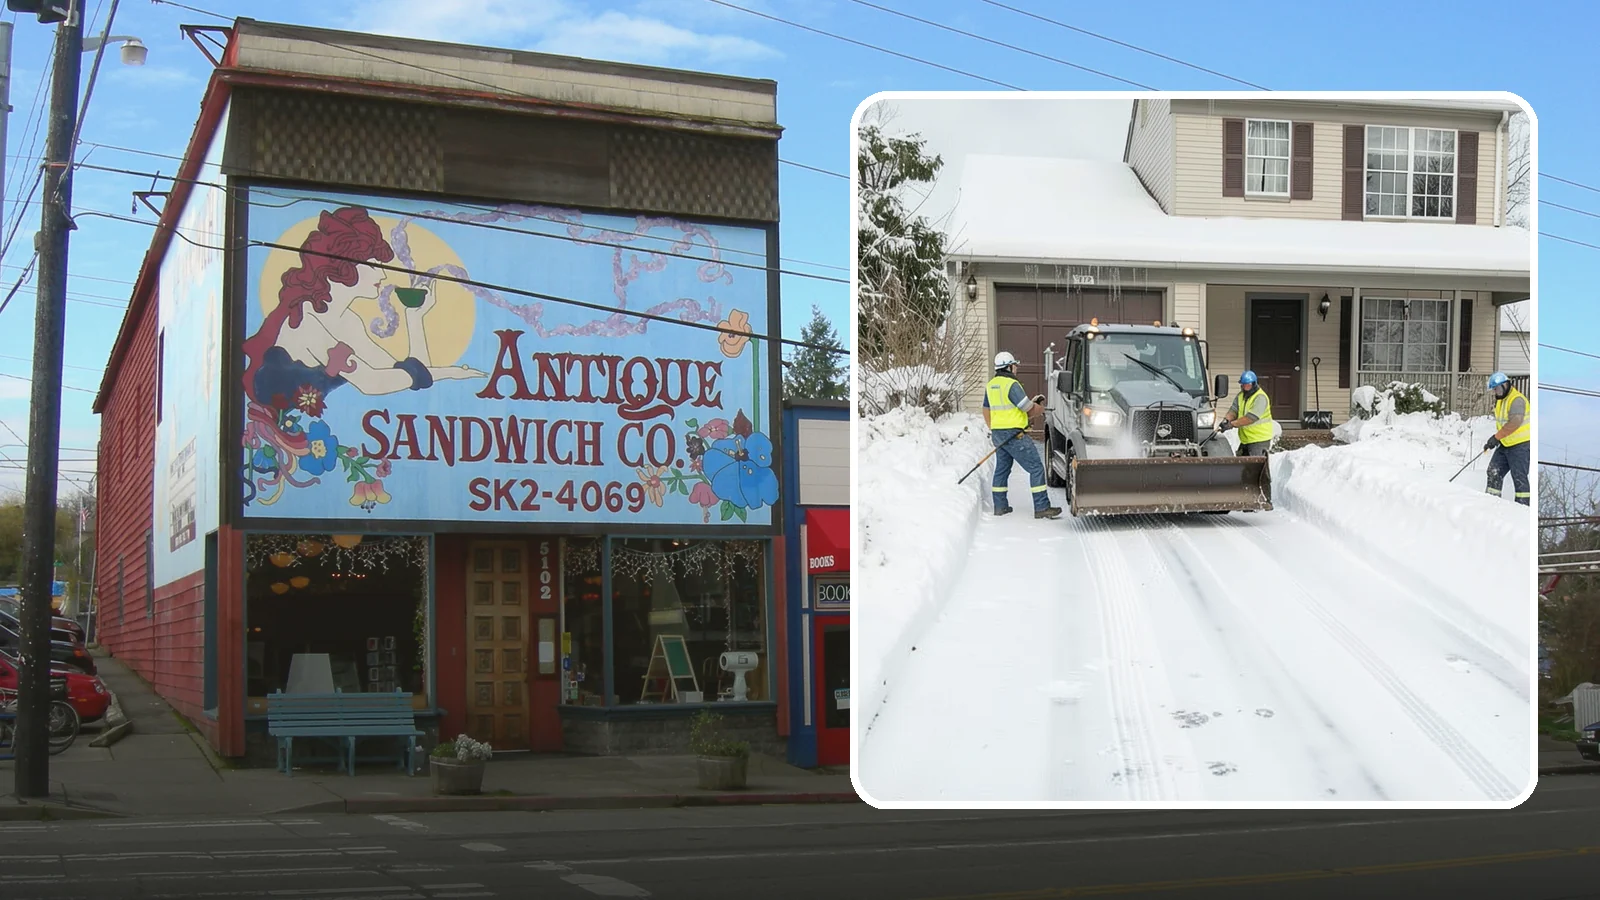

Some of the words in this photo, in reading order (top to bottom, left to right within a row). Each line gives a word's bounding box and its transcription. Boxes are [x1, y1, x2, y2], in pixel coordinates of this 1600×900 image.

[475, 329, 723, 421] ANTIQUE
[361, 408, 604, 468] SANDWICH
[616, 421, 685, 470] CO.
[468, 477, 645, 513] SK2-4069
[539, 542, 552, 600] 5102
[809, 554, 835, 569] BOOKS
